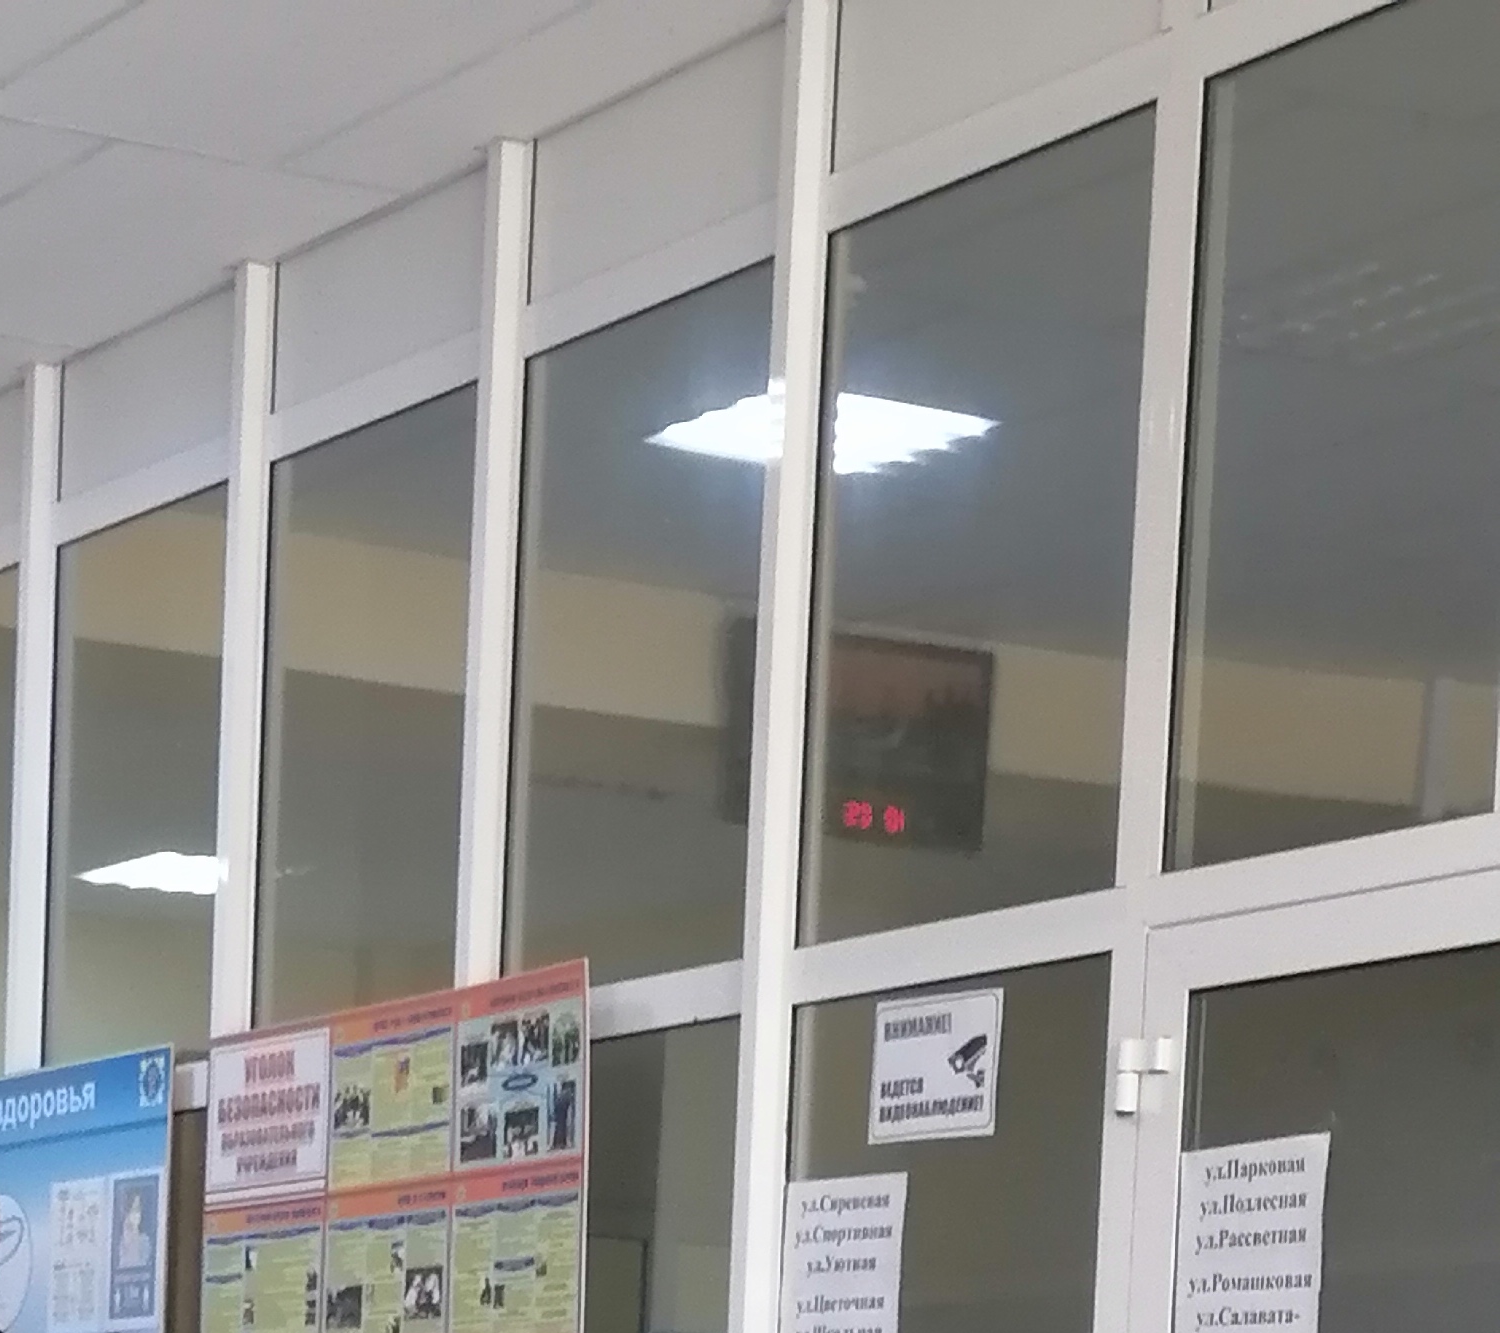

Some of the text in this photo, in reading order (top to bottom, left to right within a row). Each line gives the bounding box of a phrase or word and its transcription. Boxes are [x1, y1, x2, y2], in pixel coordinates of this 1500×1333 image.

[884, 1012, 953, 1042] ВНИМАНИЕ!
[244, 1050, 295, 1083] УГОЛОК
[218, 1083, 320, 1123] БЕЗОПАСНОСТИ
[1204, 1158, 1306, 1187] ул.Парковая
[1199, 1192, 1308, 1221] ул.Подлесная
[794, 1224, 892, 1249] ул.Спортивная
[1194, 1228, 1307, 1256] ул.Рассветная
[806, 1255, 877, 1278] ул.Уютная
[1186, 1273, 1313, 1299] ул.Ромашковая
[796, 1295, 885, 1319] ул.Цветочная
[1195, 1306, 1300, 1332] ул.Салавата-
